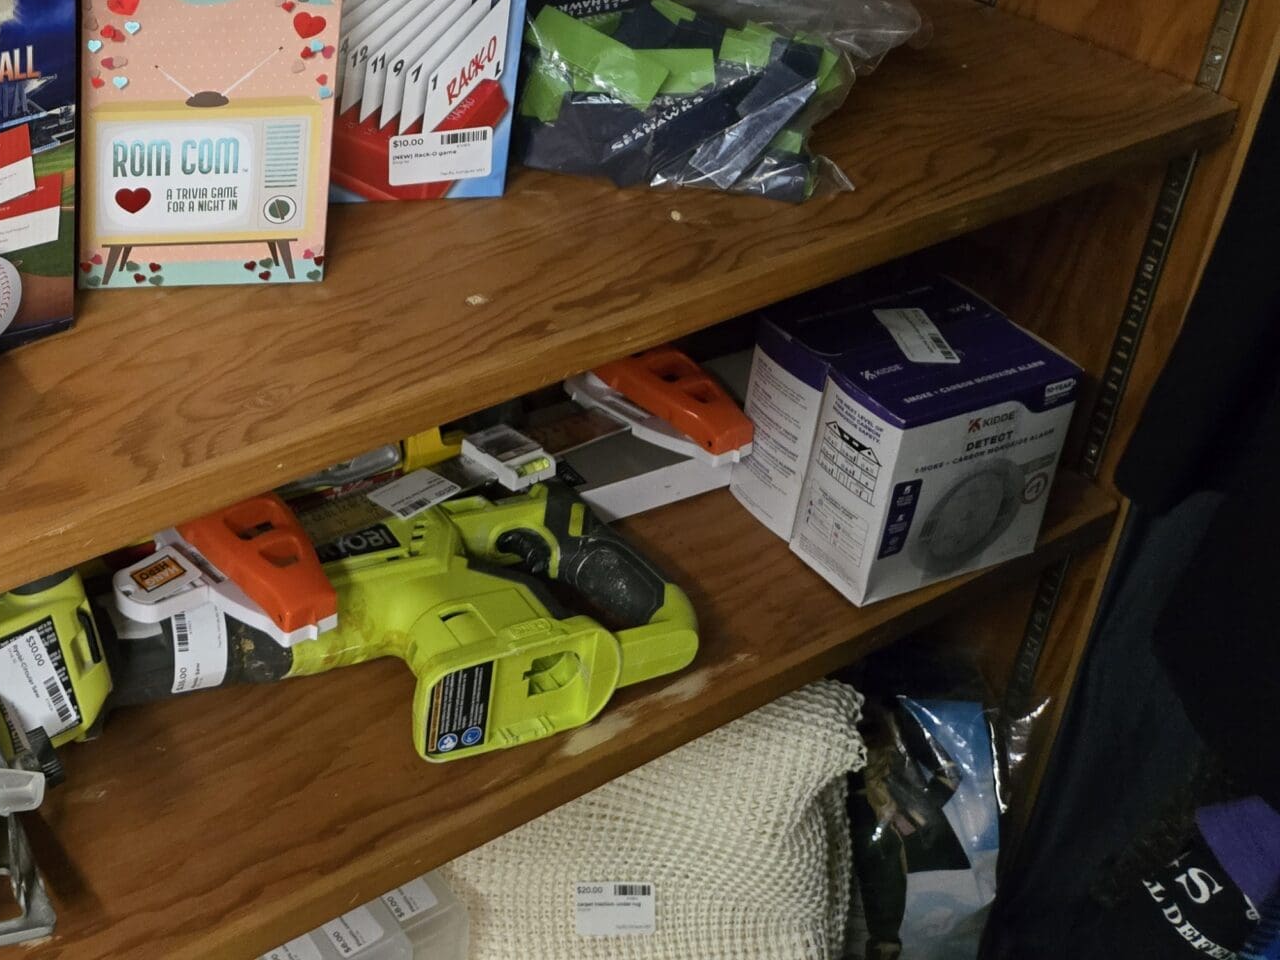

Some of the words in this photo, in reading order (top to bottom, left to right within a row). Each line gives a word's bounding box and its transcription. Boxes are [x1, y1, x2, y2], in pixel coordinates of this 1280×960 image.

[351, 46, 369, 69] 12
[371, 53, 387, 74] 11
[393, 59, 405, 77] 9
[446, 36, 498, 106] RACK-O
[393, 139, 424, 148] $10.00
[112, 139, 171, 178] ROM
[181, 136, 240, 176] COM
[166, 189, 173, 200] A
[176, 188, 207, 200] TRIVIA
[210, 187, 238, 199] GAME
[167, 201, 185, 213] FOR
[187, 201, 194, 212] A
[197, 200, 225, 212] NIGHT
[228, 199, 238, 211] IN
[982, 411, 1016, 427] KIDDE
[966, 430, 1014, 452] DETECT
[1030, 428, 1054, 440] ALARM
[26, 635, 45, 667] $30.00
[577, 886, 603, 894] $20.00
